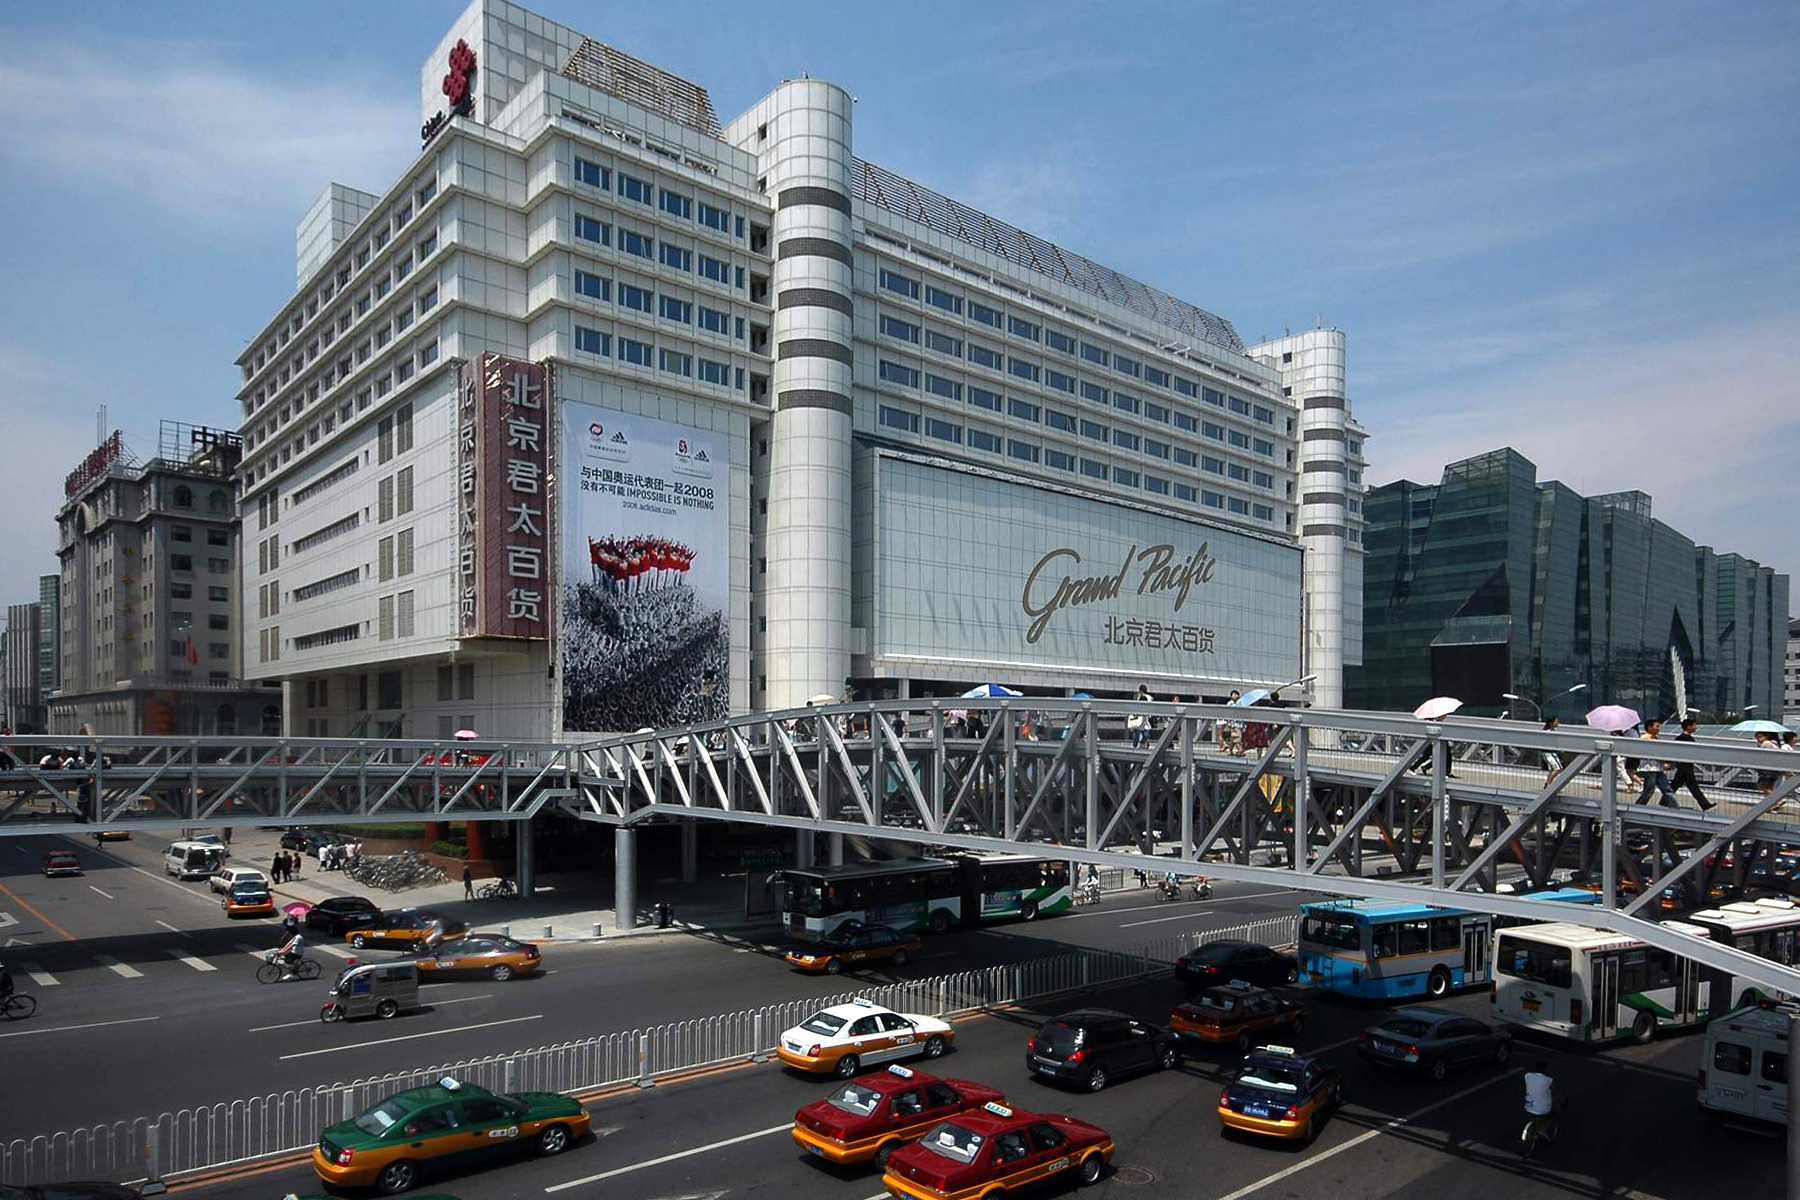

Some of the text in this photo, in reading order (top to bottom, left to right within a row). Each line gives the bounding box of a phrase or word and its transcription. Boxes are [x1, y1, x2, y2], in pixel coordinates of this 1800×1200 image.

[506, 372, 542, 622] 北京君太百货
[626, 488, 672, 504] IMPOSSIBLE
[673, 495, 682, 505] IS
[682, 497, 714, 510] NOTHING
[1023, 541, 1216, 644] Grand Pacific
[1104, 616, 1215, 655] 北京君太百货
